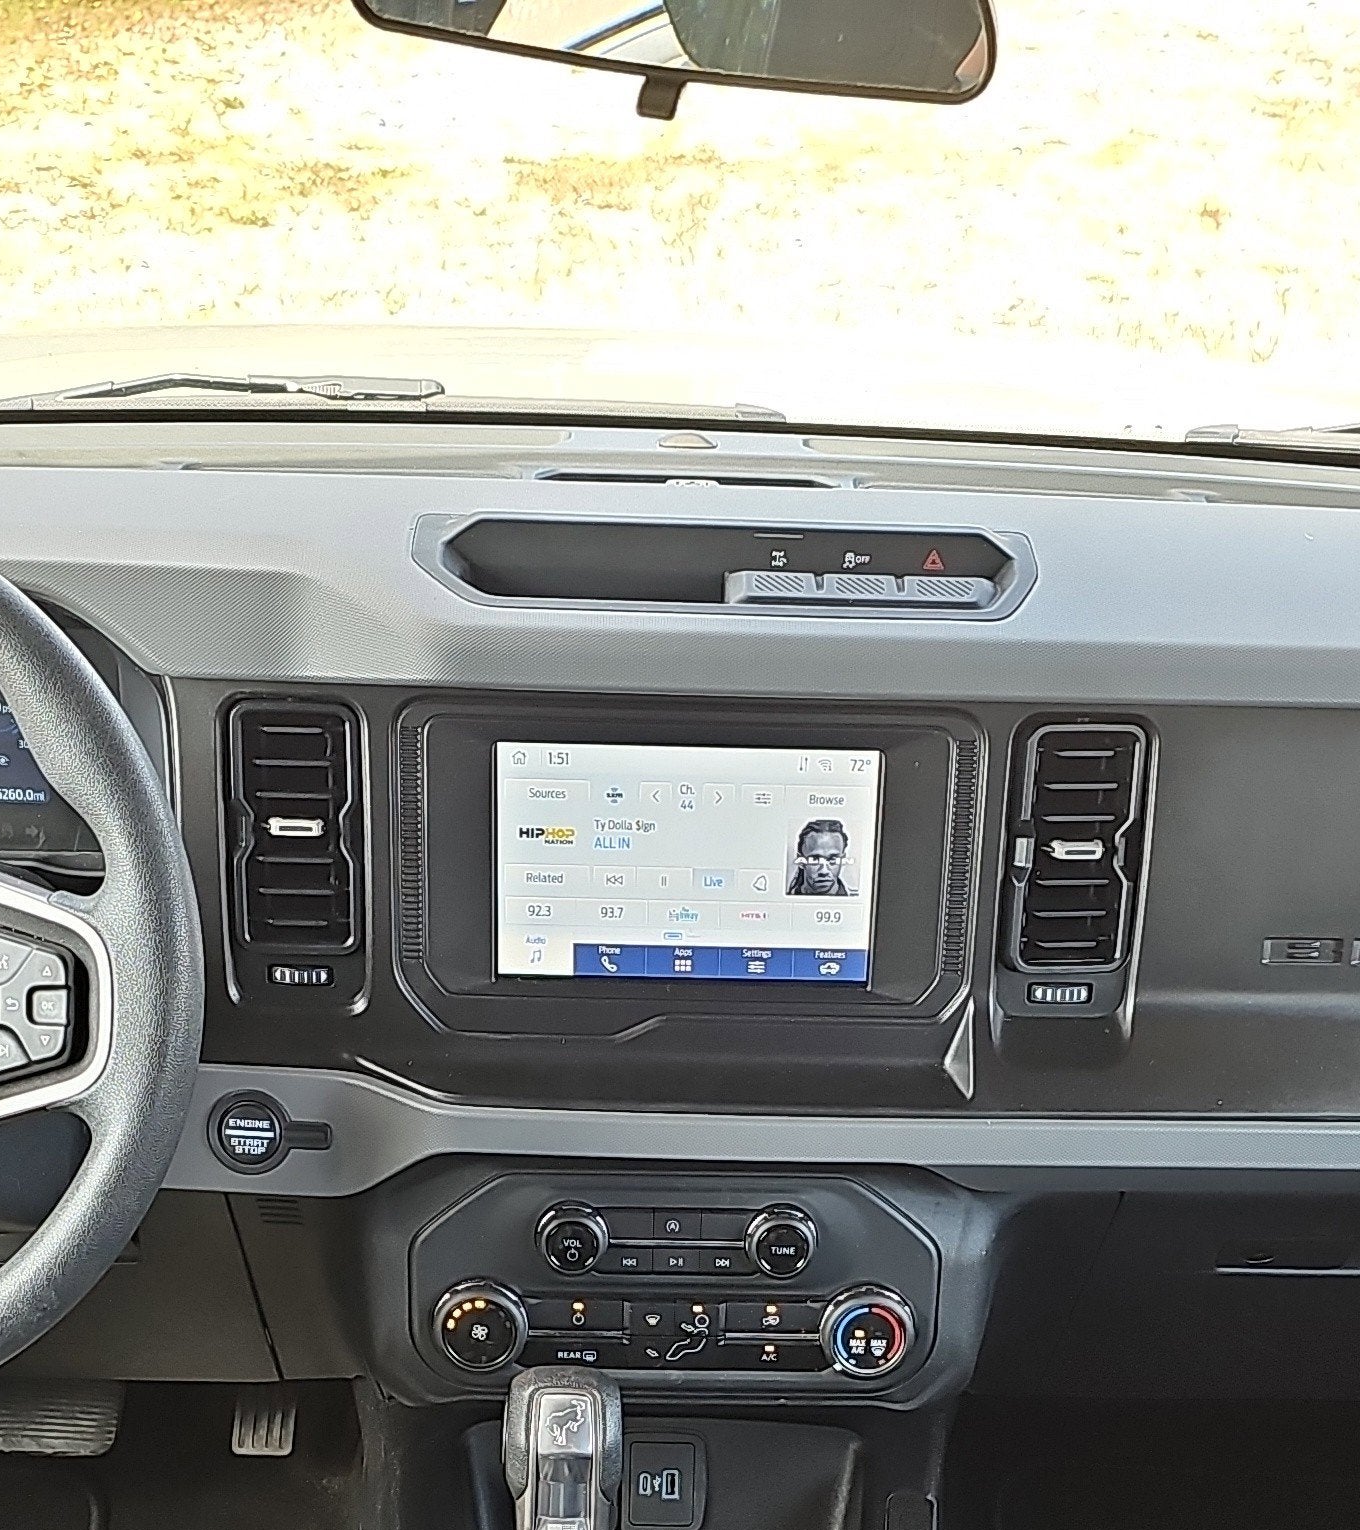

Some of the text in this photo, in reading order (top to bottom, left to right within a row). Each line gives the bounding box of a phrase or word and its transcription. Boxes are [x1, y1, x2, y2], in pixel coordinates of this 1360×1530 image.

[855, 555, 871, 564] OFF
[548, 752, 569, 765] 1:51
[850, 759, 871, 772] 72°
[528, 788, 567, 799] Sources
[679, 784, 695, 795] Ch.
[809, 794, 845, 805] Browse
[680, 800, 693, 810] 44
[594, 819, 606, 831] Ty
[608, 819, 633, 831] Dolla
[594, 837, 630, 849] ALL IN
[526, 873, 563, 884] Related
[704, 876, 723, 887] Live
[528, 905, 551, 917] 92.3
[600, 907, 624, 918] 93.7
[816, 911, 841, 923] 99.9
[525, 935, 546, 945] Audio
[598, 945, 621, 954] Phone
[673, 947, 693, 957] Apps
[742, 949, 772, 959] Settings
[815, 950, 846, 959] Features
[41, 1001, 56, 1011] OK
[228, 1119, 271, 1129] ENGINE
[230, 1137, 270, 1148] START
[234, 1146, 266, 1155] STOP
[563, 1239, 582, 1248] VOL
[771, 1246, 795, 1255] TUNE
[849, 1338, 866, 1347] MAX
[870, 1338, 887, 1347] MAX
[557, 1351, 581, 1359] REAR
[761, 1352, 777, 1362] A/C
